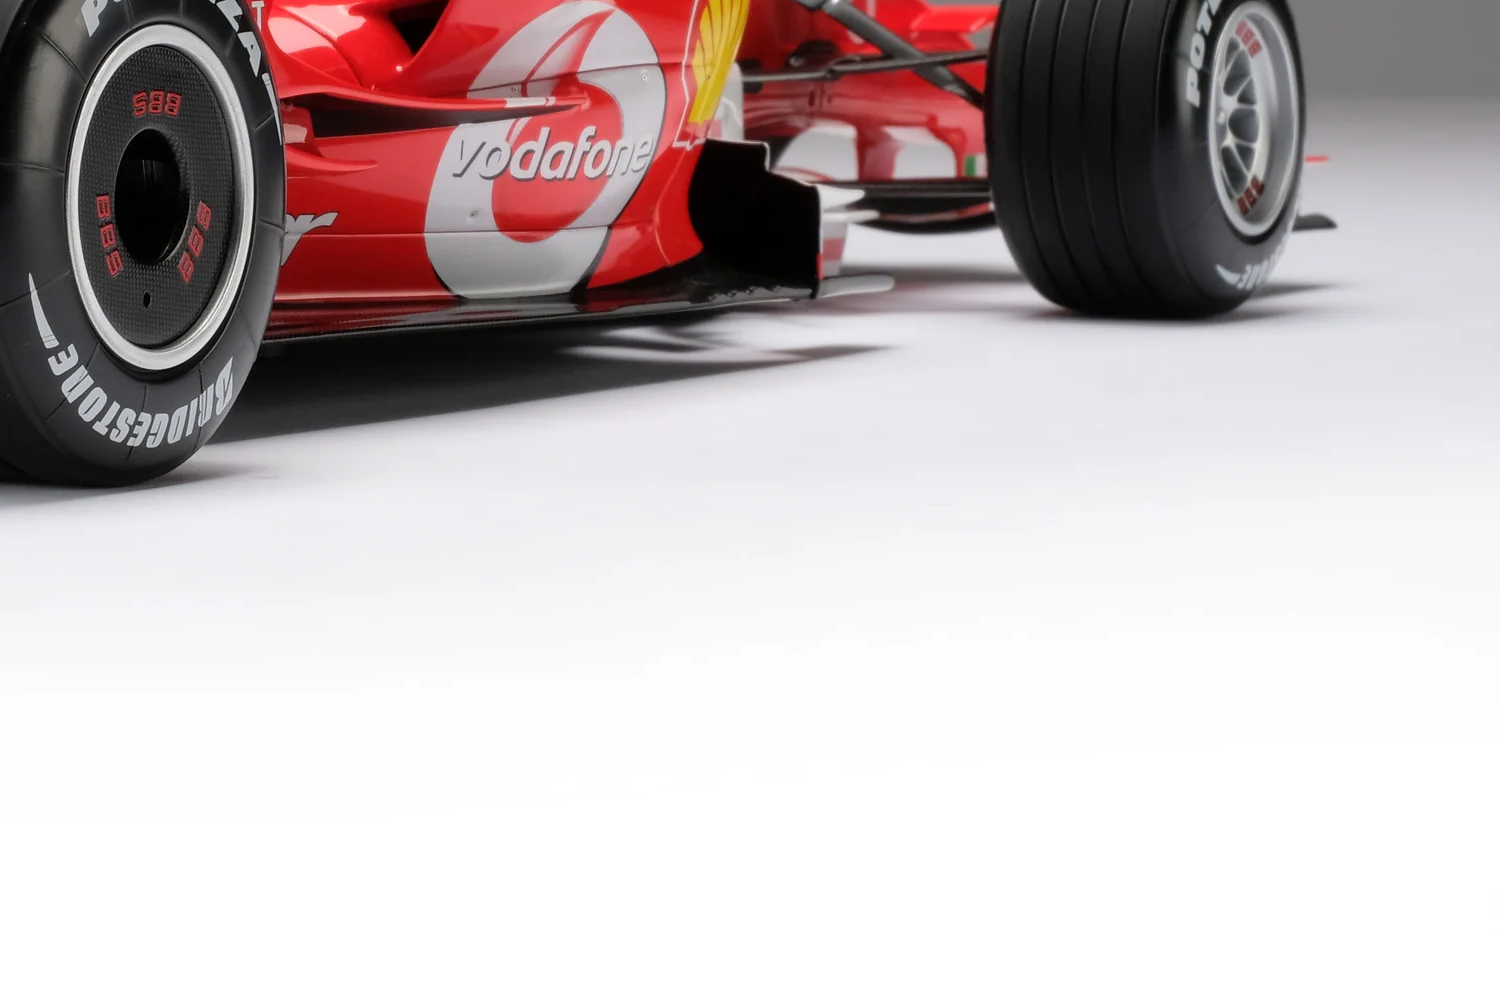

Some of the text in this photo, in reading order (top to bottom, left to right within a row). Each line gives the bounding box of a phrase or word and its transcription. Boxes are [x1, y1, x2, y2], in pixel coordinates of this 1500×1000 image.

[132, 90, 182, 117] BBS
[452, 125, 655, 182] vodafone
[47, 343, 235, 449] BRIDGESTONE
